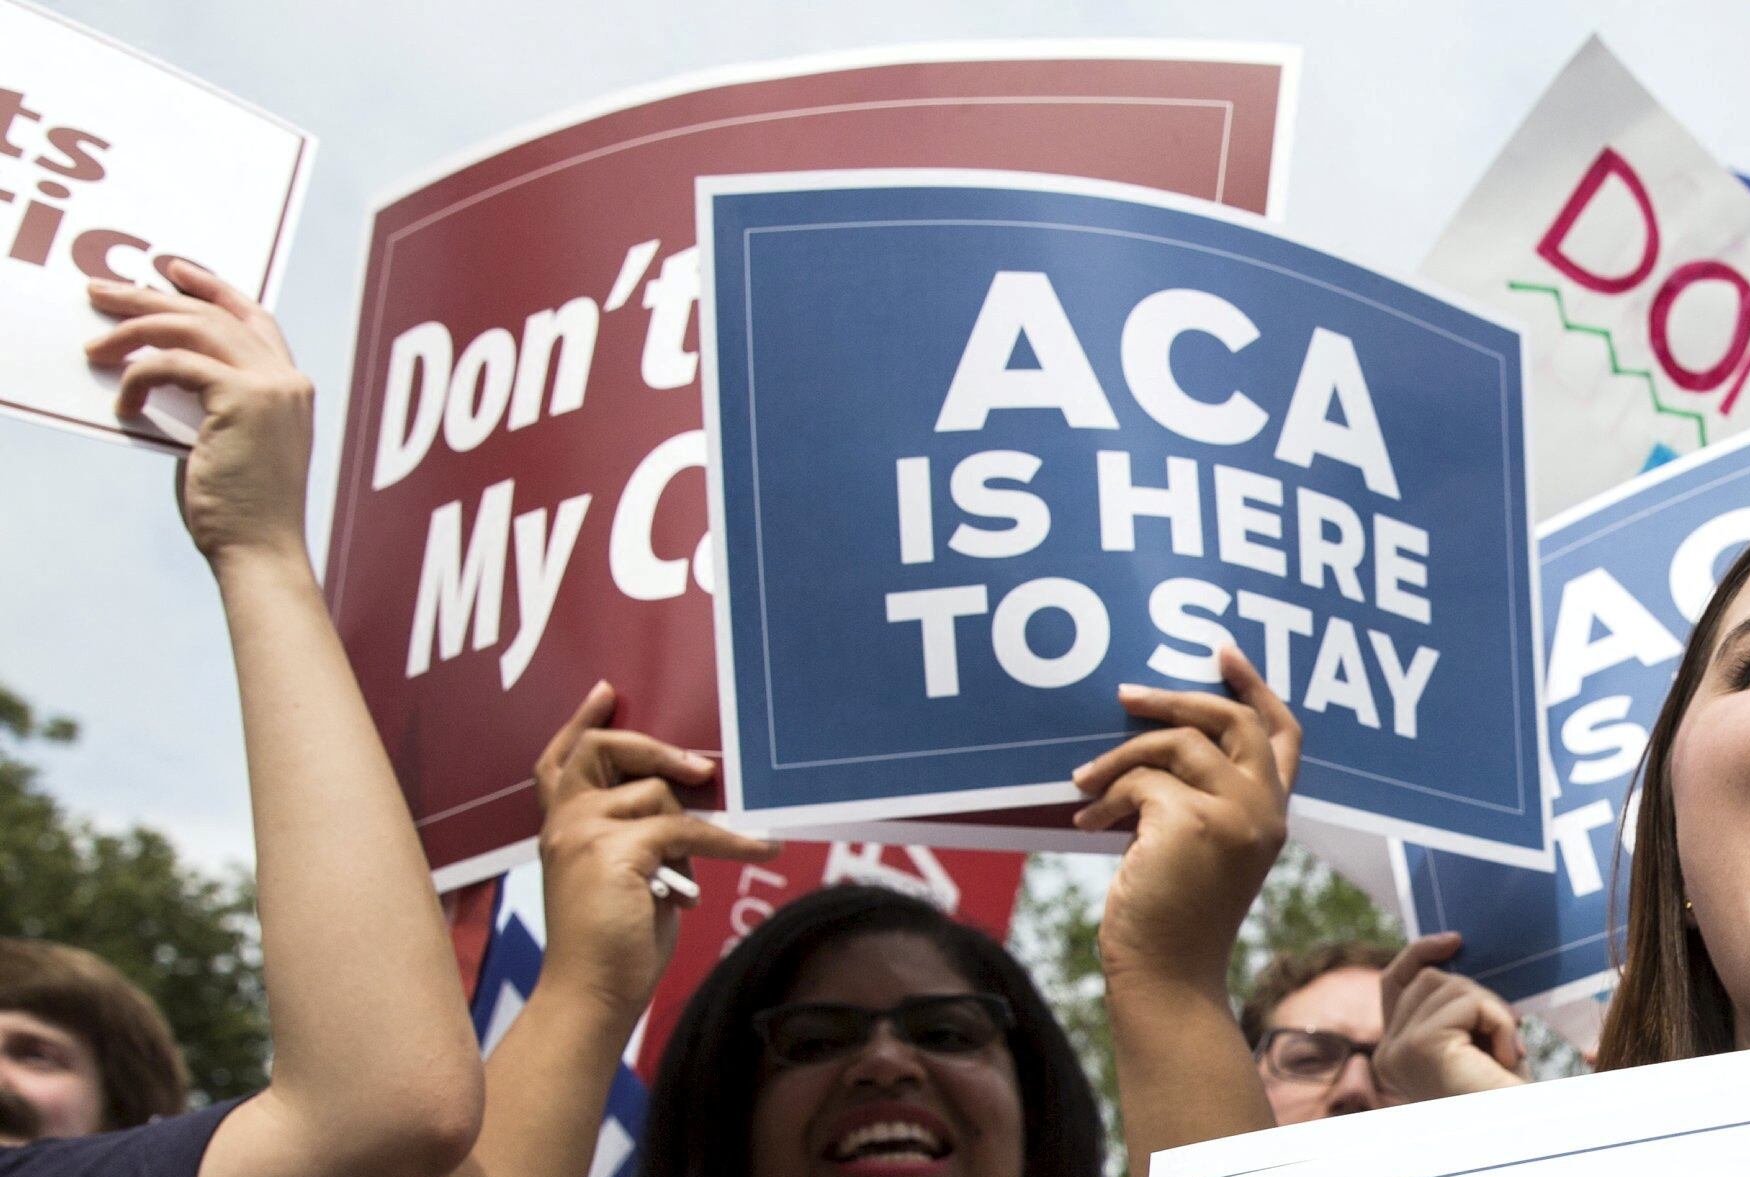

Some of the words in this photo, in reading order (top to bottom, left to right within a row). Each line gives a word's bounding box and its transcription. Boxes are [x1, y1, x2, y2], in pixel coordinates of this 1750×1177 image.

[934, 271, 1401, 500] ACA
[406, 479, 591, 691] My
[896, 450, 1052, 565] IS
[1097, 450, 1432, 625] HERE
[885, 577, 1111, 699] TO
[1146, 577, 1440, 739] STAY
